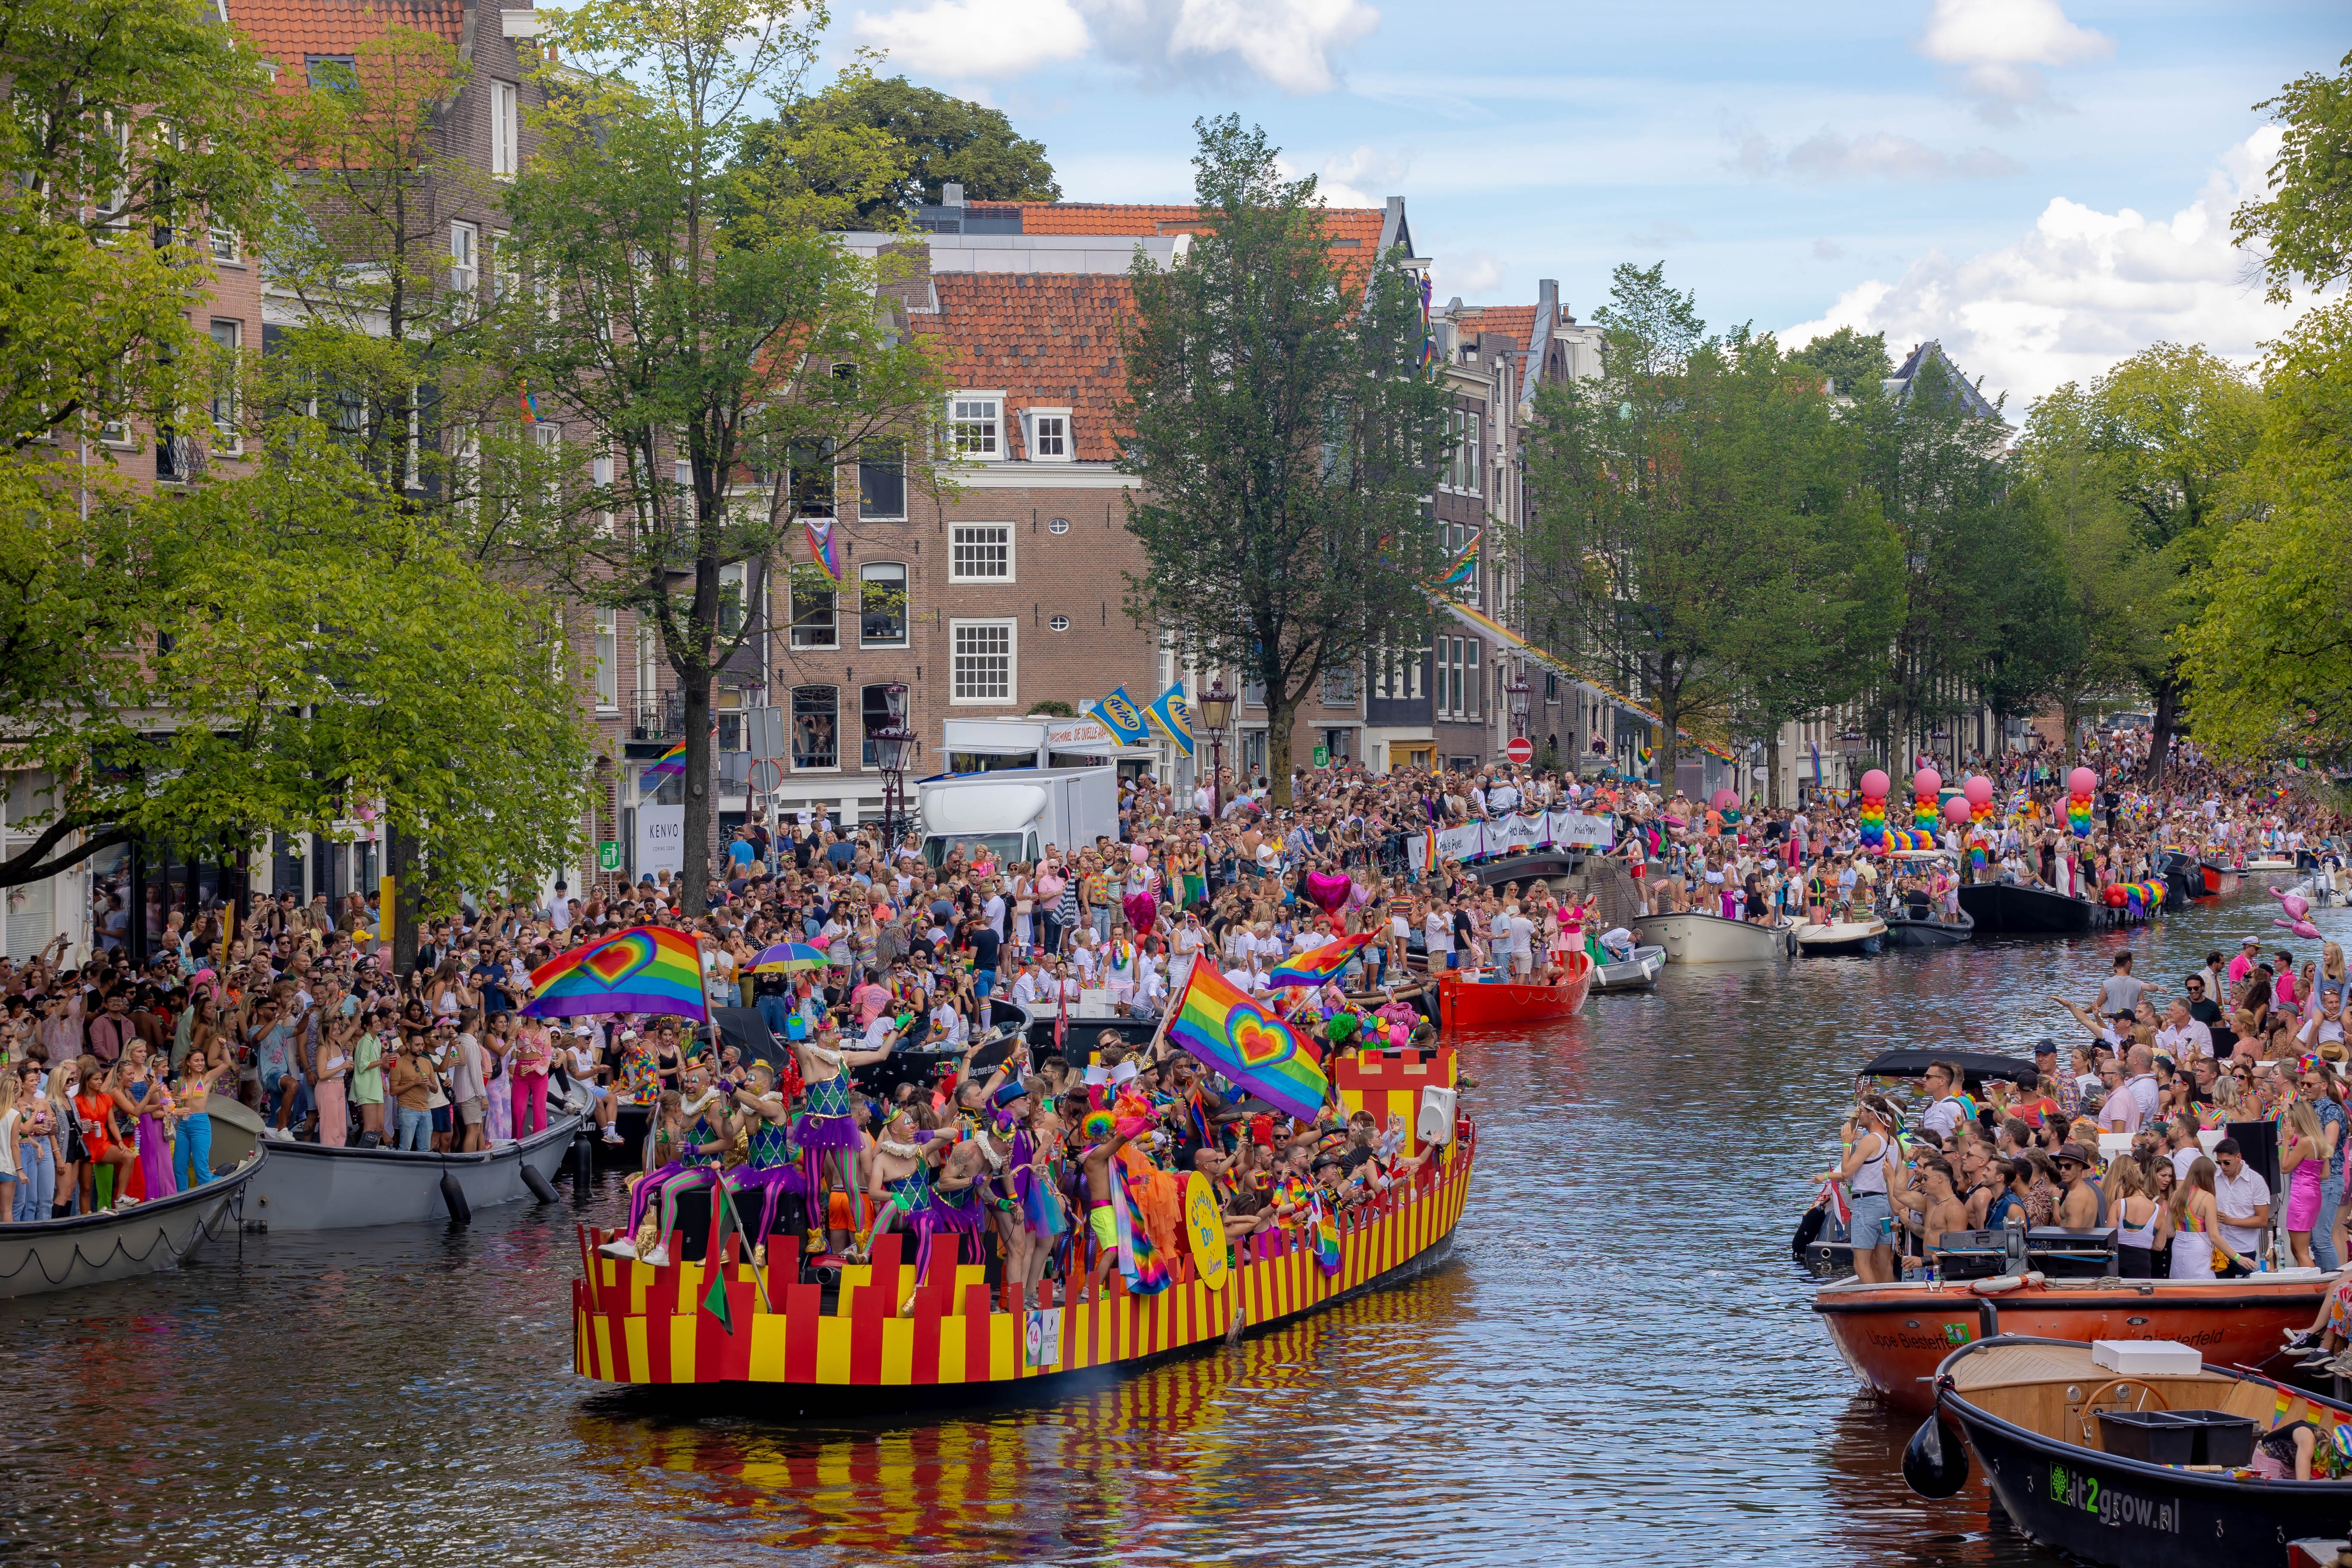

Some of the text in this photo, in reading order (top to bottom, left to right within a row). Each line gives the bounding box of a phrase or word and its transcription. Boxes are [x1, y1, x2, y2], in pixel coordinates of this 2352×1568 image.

[1105, 698, 1138, 728] Aviko
[1074, 727, 1081, 741] DE
[1081, 726, 1098, 741] SNELLE
[650, 824, 678, 838] KENVO
[978, 1067, 987, 1075] more
[987, 1064, 995, 1073] than
[1029, 1330, 1038, 1344] 14
[1043, 1334, 1058, 1344] BAREFOOT
[1867, 1330, 1898, 1350] Lippe
[2072, 1470, 2179, 1534] it2grow.nl
